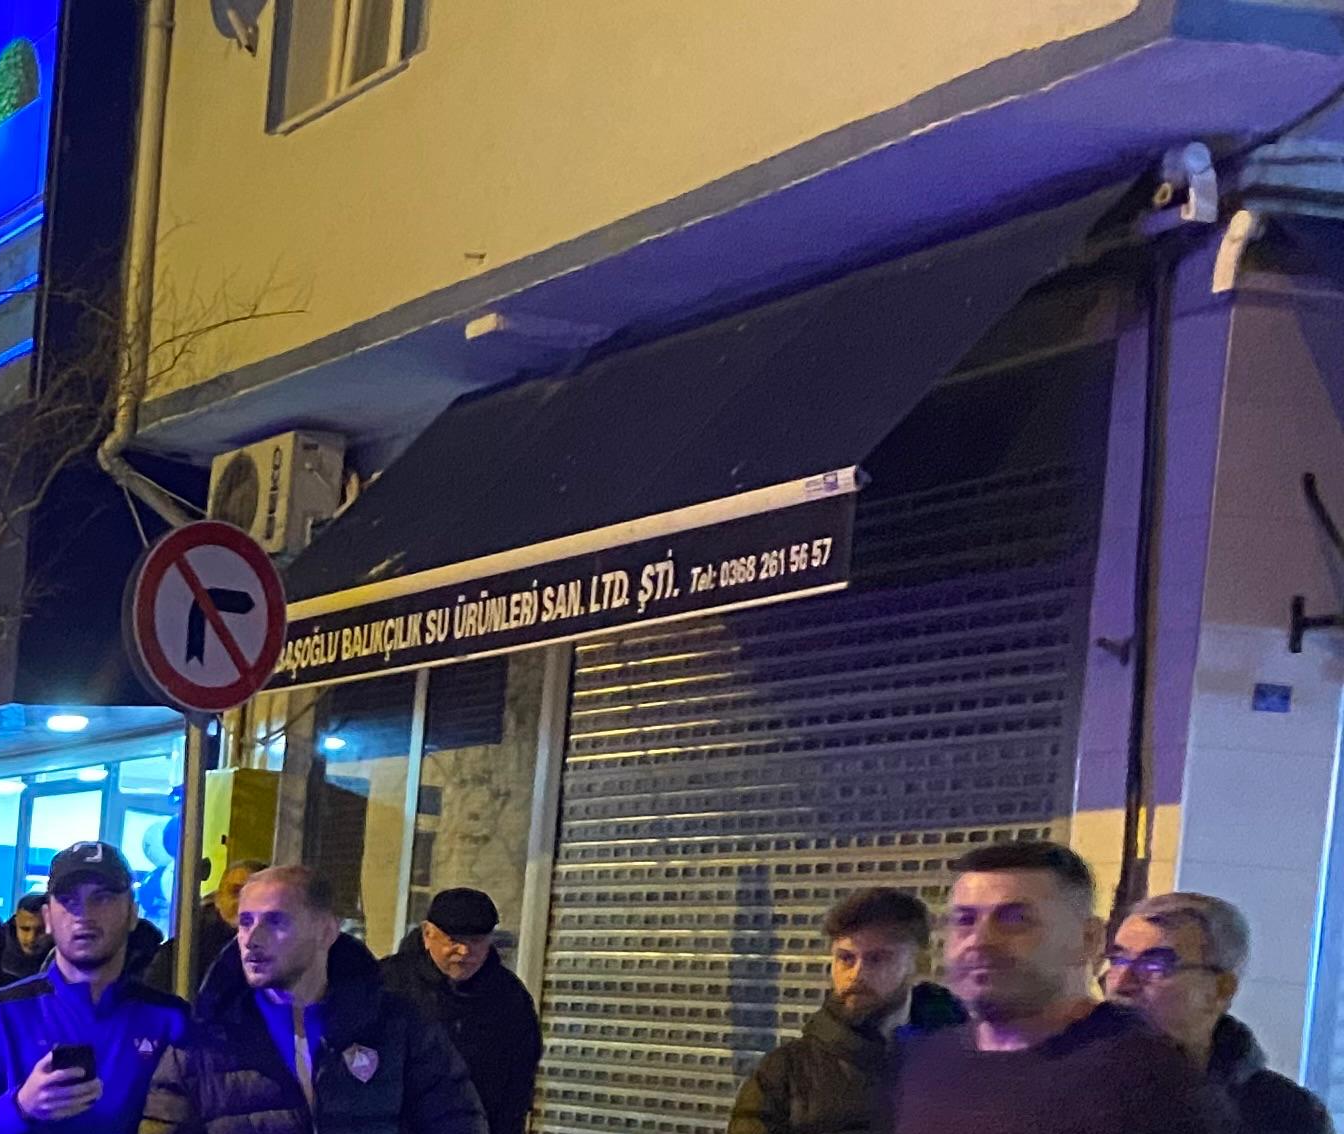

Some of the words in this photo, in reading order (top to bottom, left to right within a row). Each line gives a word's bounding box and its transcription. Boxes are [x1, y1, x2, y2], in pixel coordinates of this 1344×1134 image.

[341, 611, 423, 662] BALIKÇILIK
[425, 607, 451, 644] SU
[452, 580, 539, 640] ÜRÜNLERİ
[541, 579, 585, 622] SAN.
[589, 570, 631, 614] LTD.
[637, 549, 680, 614] ŞTİ.
[719, 555, 756, 587] 0368
[759, 548, 785, 580] 261
[789, 542, 809, 573] 56
[811, 537, 833, 568] 57
